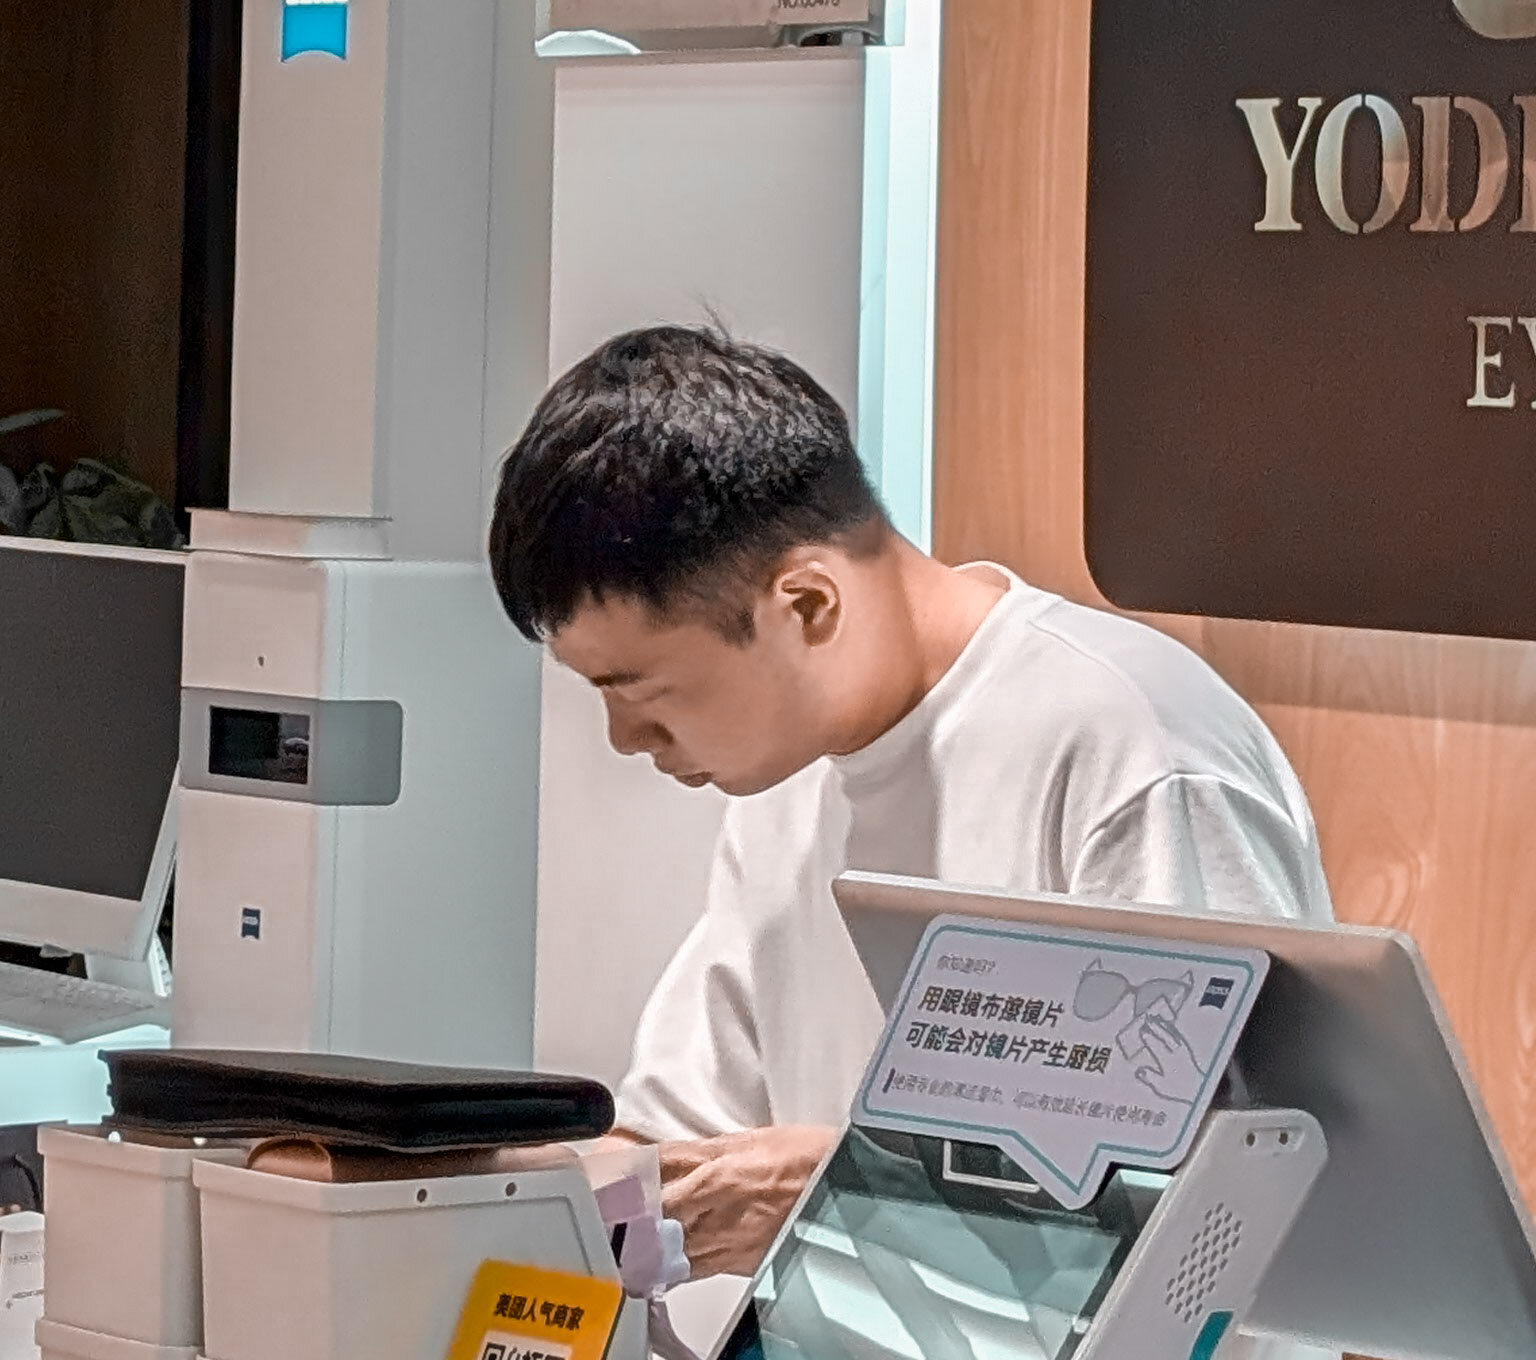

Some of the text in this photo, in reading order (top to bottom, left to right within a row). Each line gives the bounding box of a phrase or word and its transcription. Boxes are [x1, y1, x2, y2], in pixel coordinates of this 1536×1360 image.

[1235, 94, 1536, 233] YOD
[918, 985, 1066, 1029] 用眼镜布擦镜片
[905, 1020, 1113, 1076] 可能会对镜片产生磨损
